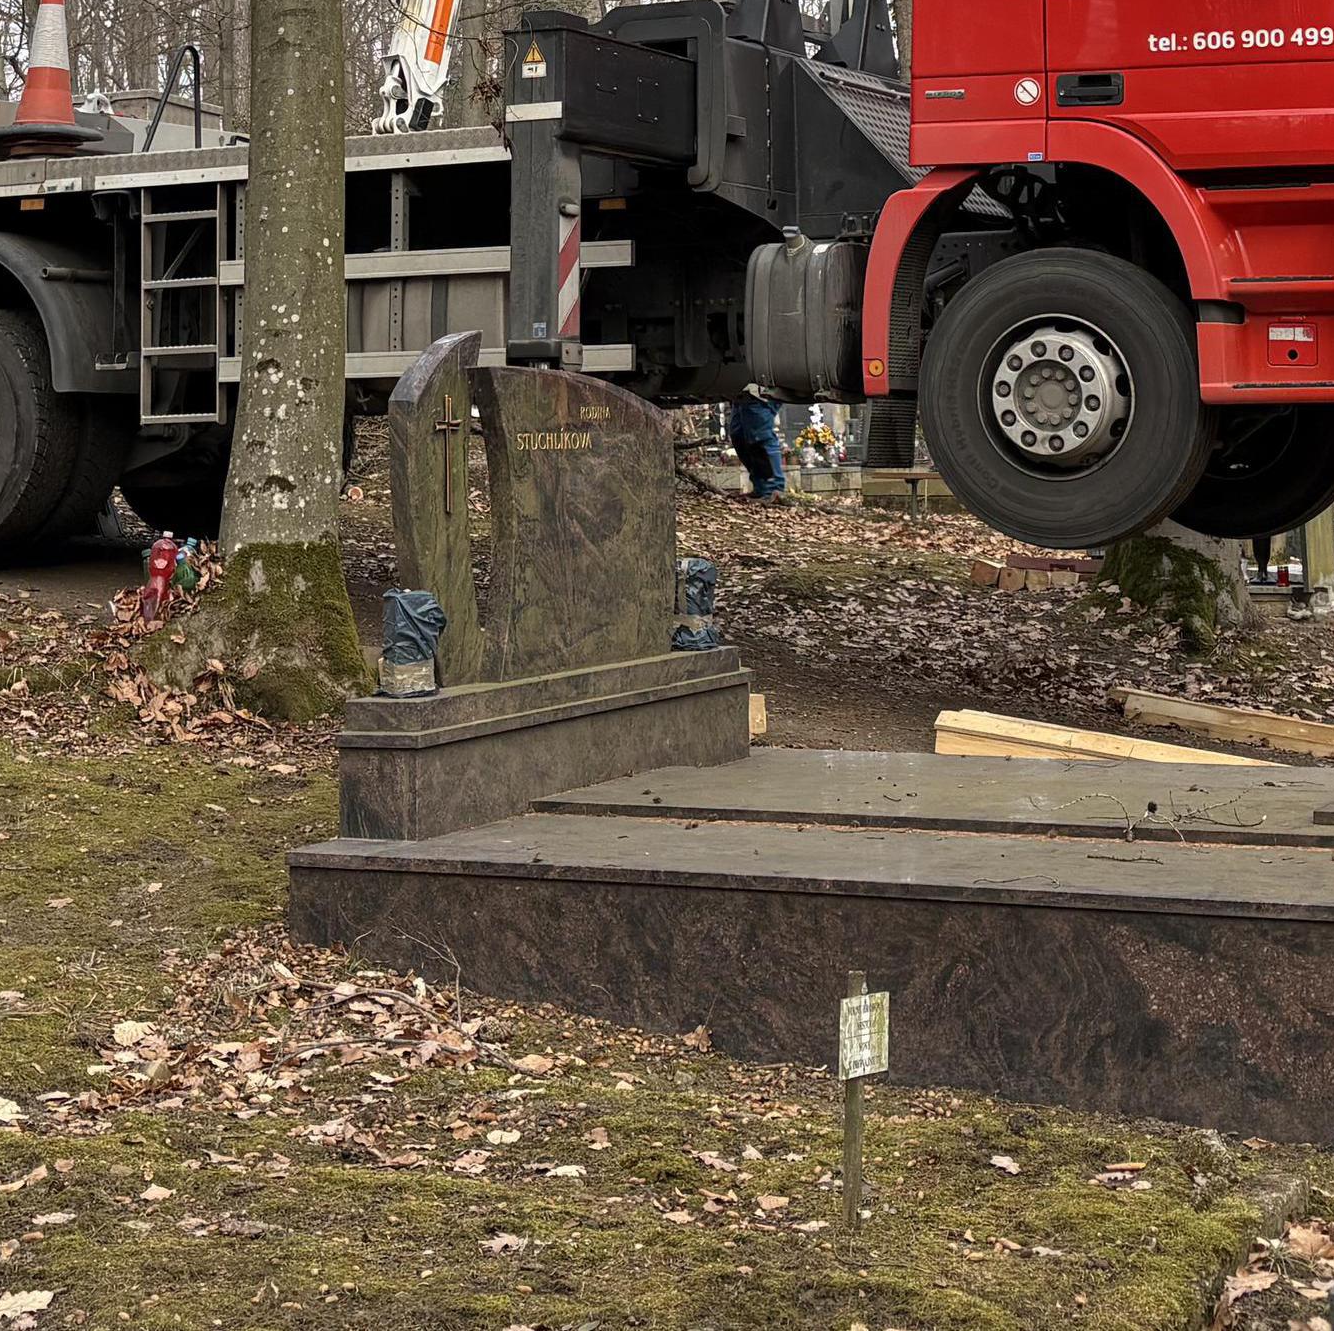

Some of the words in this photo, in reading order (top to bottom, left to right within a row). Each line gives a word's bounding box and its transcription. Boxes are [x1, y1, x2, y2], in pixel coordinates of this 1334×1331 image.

[1148, 33, 1188, 52] tel.:
[1192, 31, 1236, 50] 606
[1241, 29, 1285, 49] 900
[1290, 27, 1334, 46] 499
[579, 406, 611, 420] RODINA
